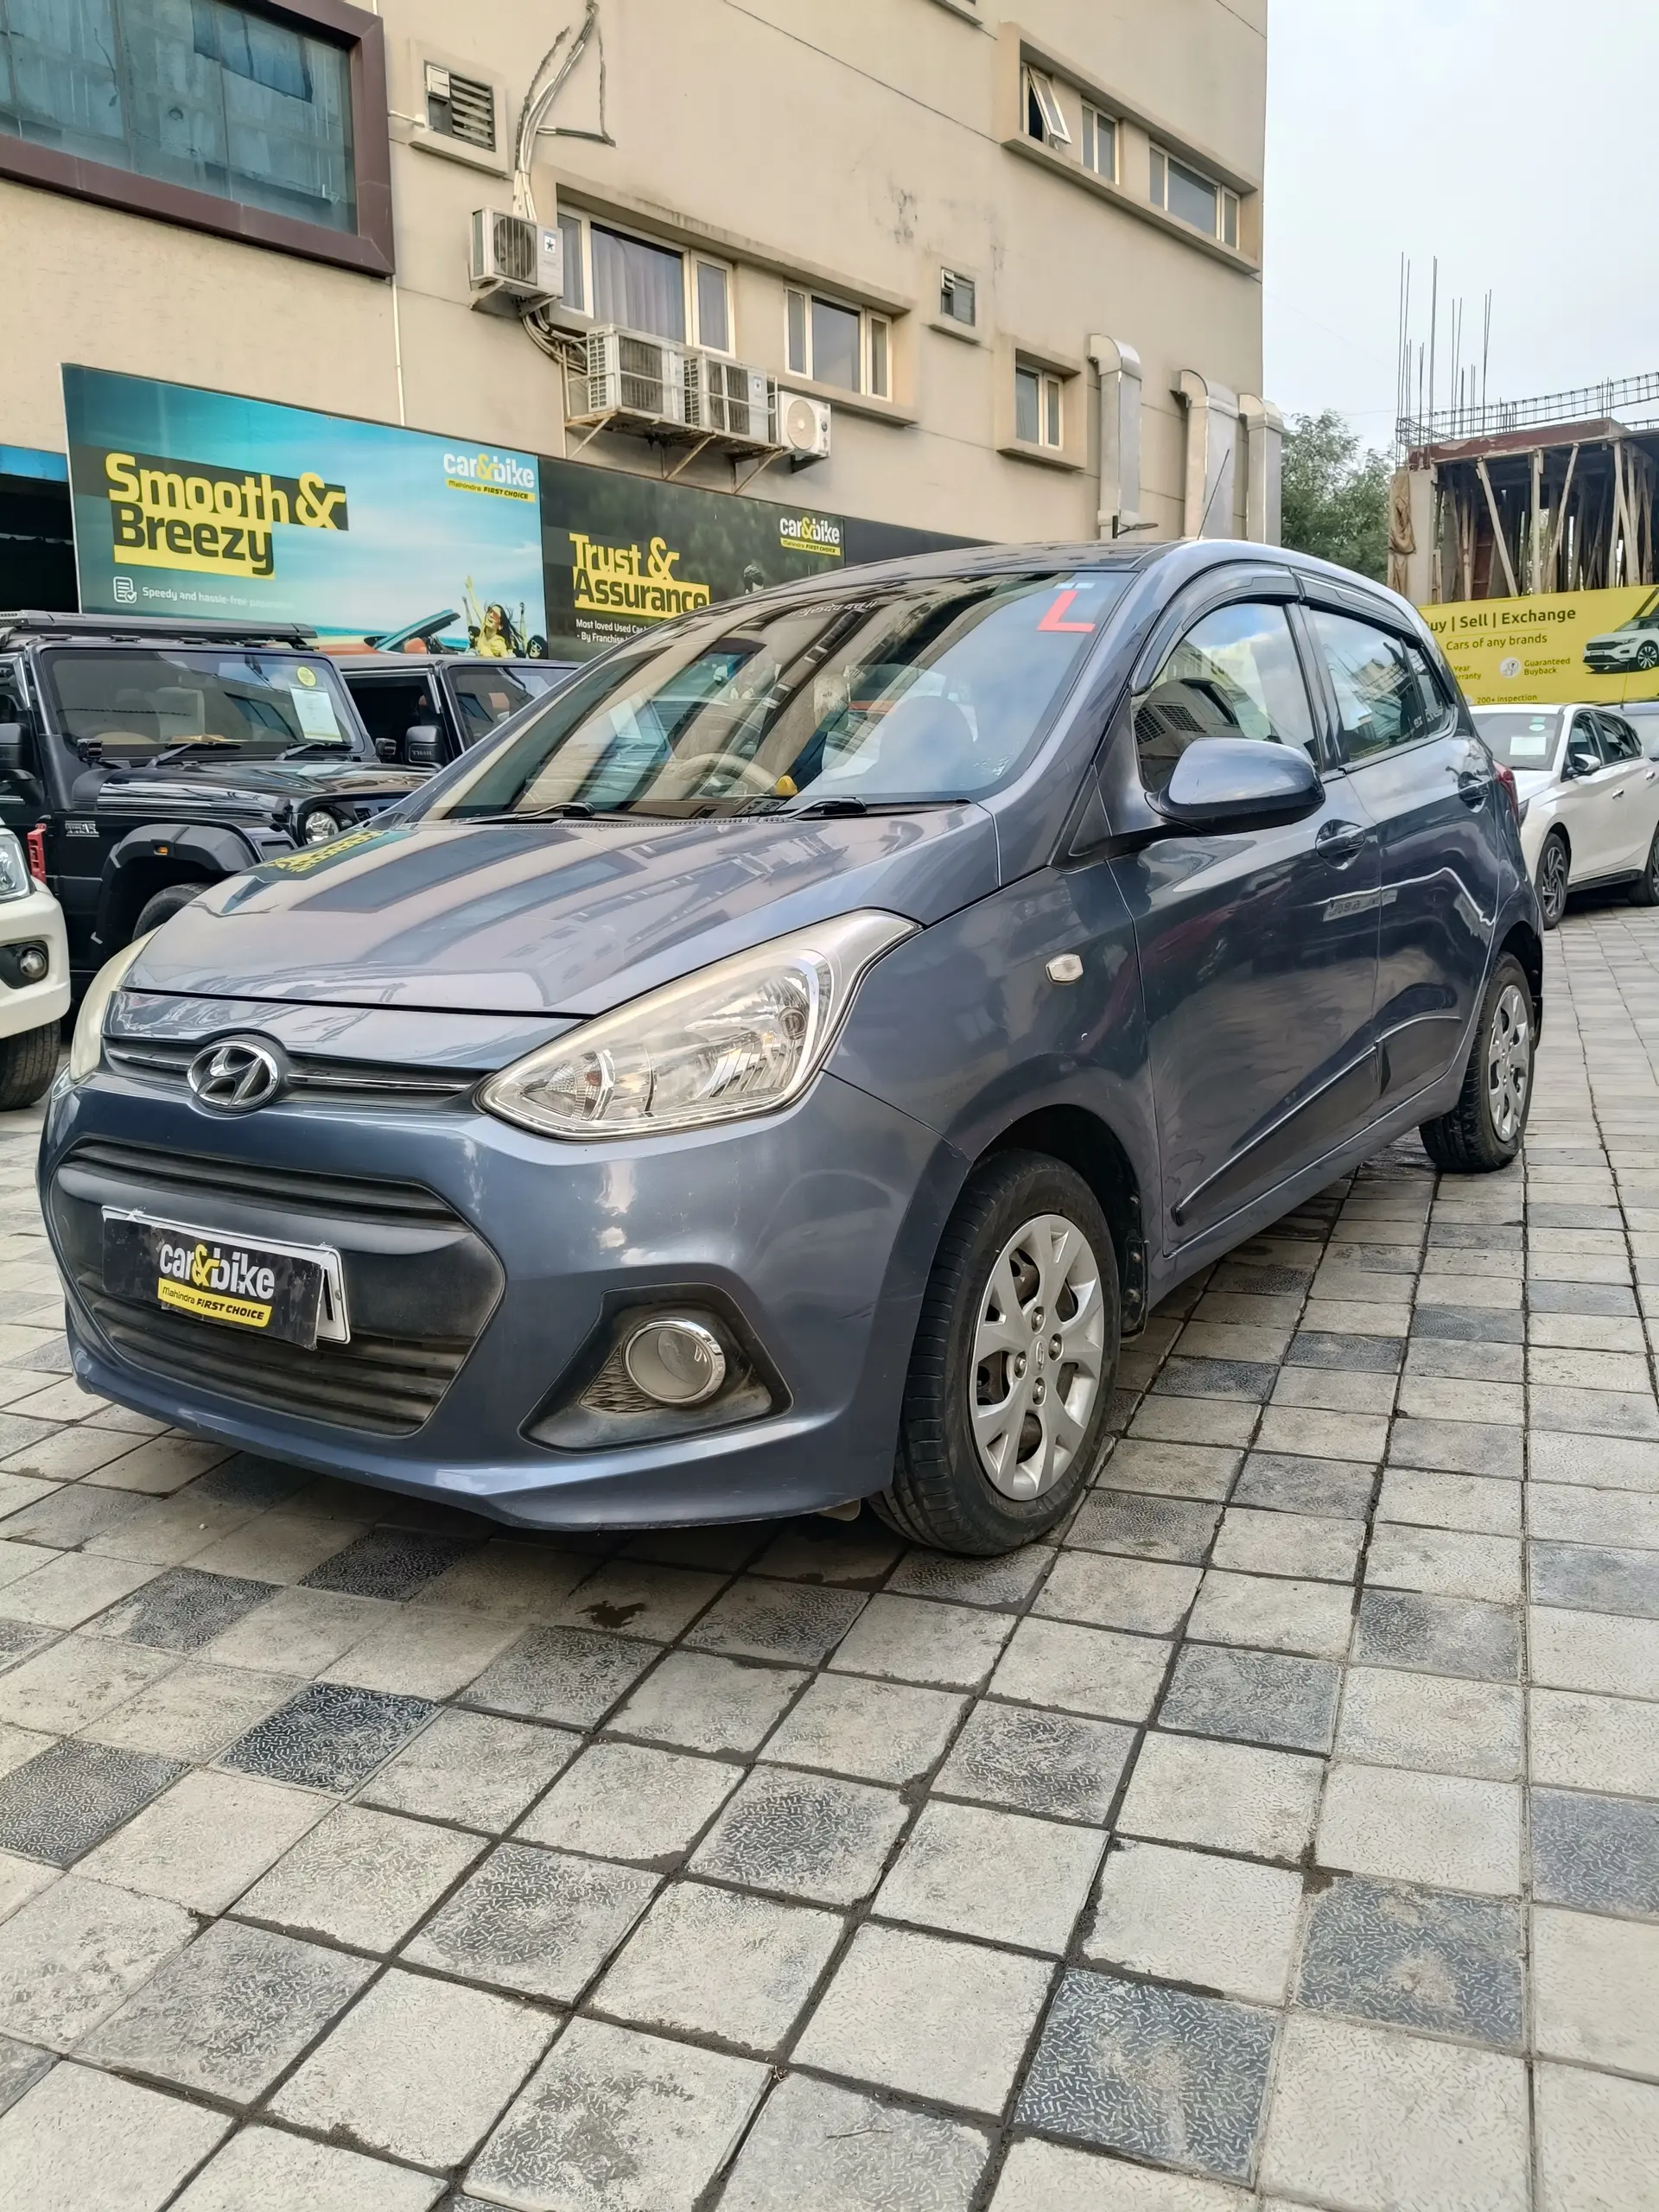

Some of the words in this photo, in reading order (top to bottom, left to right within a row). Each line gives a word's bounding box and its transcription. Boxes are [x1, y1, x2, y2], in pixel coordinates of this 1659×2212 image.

[443, 453, 535, 488] car&bike
[483, 486, 503, 495] FIRST
[504, 490, 529, 499] CHOICE
[111, 499, 274, 576] Breezy
[779, 516, 840, 544] car&bike
[569, 532, 641, 576] Trust
[647, 536, 680, 581] &
[142, 587, 177, 601] Speedy
[180, 591, 197, 601] and
[199, 592, 248, 606] hassle-free
[575, 568, 707, 613] Assurance
[575, 618, 594, 629] Most
[594, 620, 613, 631] loved
[614, 622, 631, 633] Used
[1428, 620, 1446, 633] uy
[1459, 613, 1488, 628] Sell
[1502, 609, 1576, 625] Exchange
[581, 632, 591, 643] By
[1446, 640, 1470, 651] Cars
[1472, 638, 1484, 648] of
[1486, 638, 1506, 649] any
[1509, 633, 1548, 645] brands
[1523, 666, 1557, 677] Buyback
[1524, 658, 1570, 667] Guaranteed
[1497, 694, 1537, 702] inspection
[159, 1243, 275, 1300] car&bike
[162, 1287, 195, 1305] Mahindra
[196, 1298, 226, 1312] FIRST
[226, 1305, 264, 1320] CHOICE
